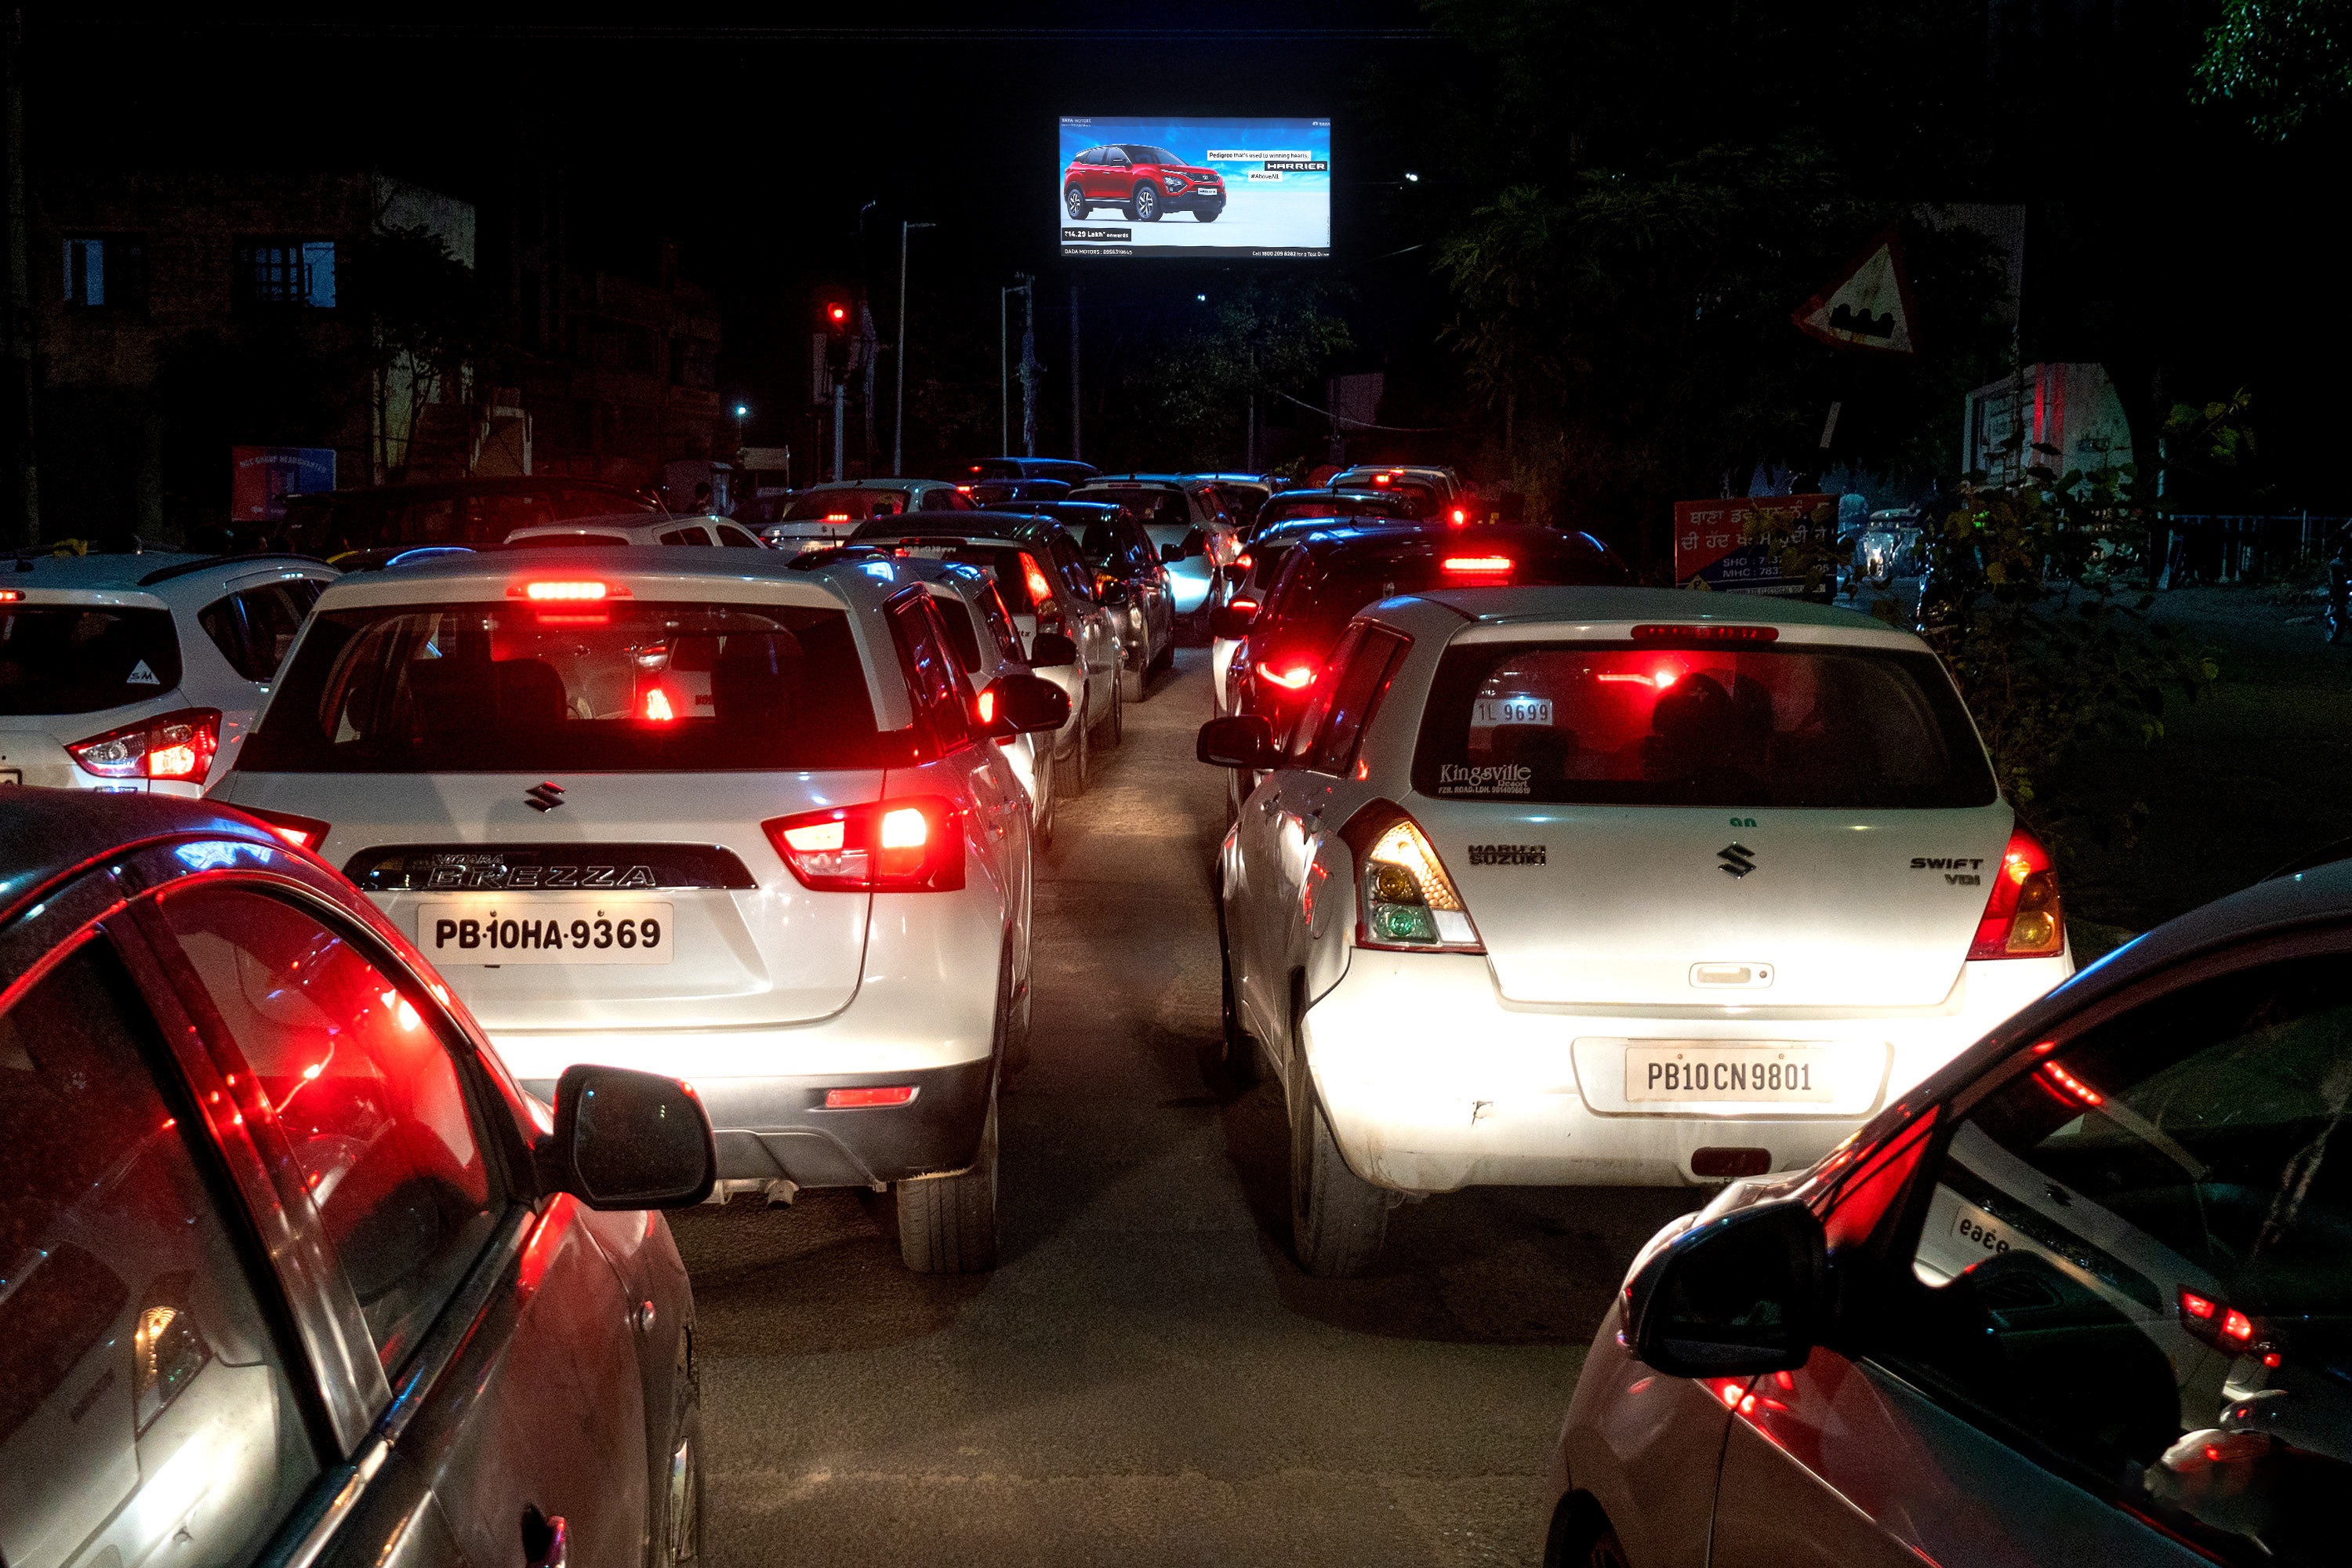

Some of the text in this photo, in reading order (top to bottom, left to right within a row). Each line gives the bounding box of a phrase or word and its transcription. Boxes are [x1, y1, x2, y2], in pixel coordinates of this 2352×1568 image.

[1681, 531, 1699, 550] ਦੀ
[1722, 568, 1751, 578] MHC
[1504, 703, 1548, 720] 9699
[1439, 764, 1532, 786] Kingsville
[1468, 844, 1546, 854] MARUTI
[432, 853, 504, 864] VITARA
[1468, 852, 1546, 866] SUZUKI
[1910, 857, 1984, 870] SWIFT
[427, 864, 657, 888] BREZZA
